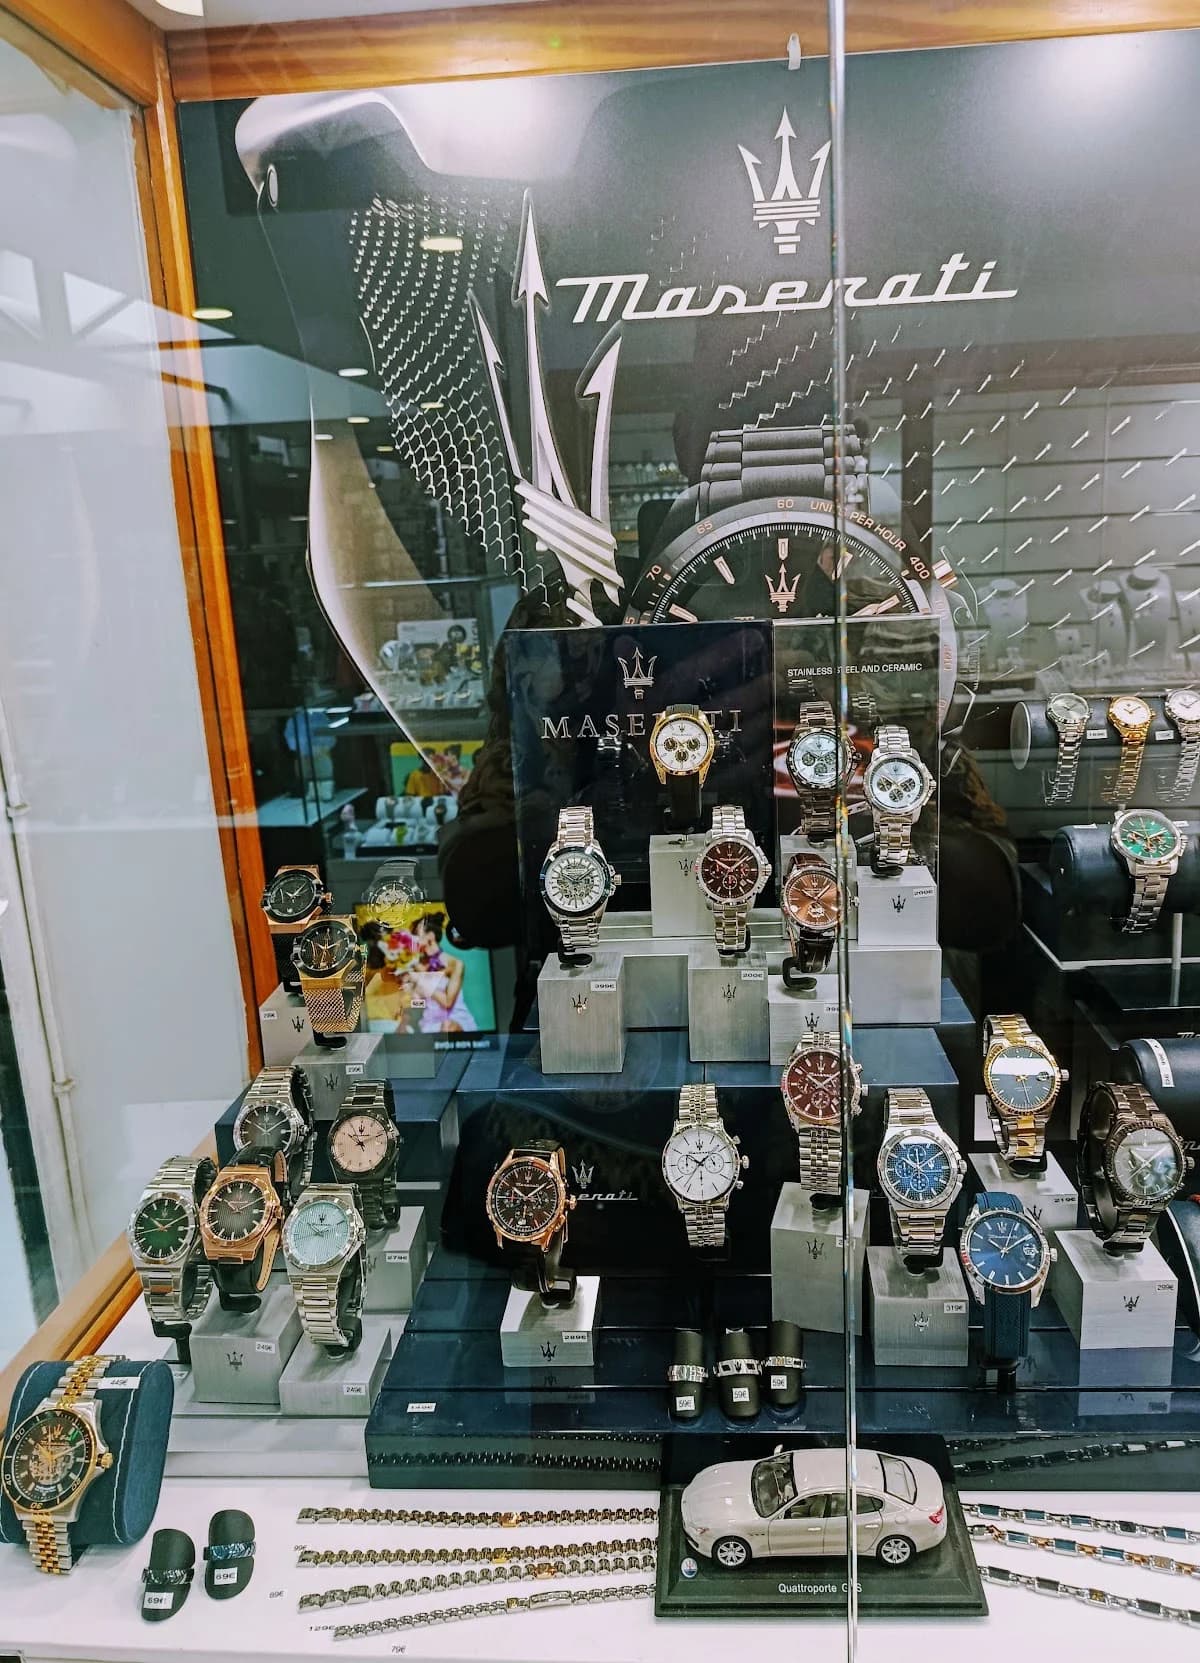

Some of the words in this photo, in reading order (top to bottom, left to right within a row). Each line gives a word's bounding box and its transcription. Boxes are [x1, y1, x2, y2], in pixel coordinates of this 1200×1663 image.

[556, 252, 1018, 323] Maserati
[777, 499, 794, 509] 60
[696, 520, 713, 534] 65
[850, 511, 873, 529] PER
[874, 524, 907, 552] HOUR
[909, 556, 931, 580] 400
[646, 565, 662, 581] 70
[787, 666, 833, 677] STAINLESS
[861, 664, 881, 674] AND
[881, 662, 923, 673] CERAMIC
[541, 709, 743, 739] MASETI
[778, 1583, 838, 1595] Quattroporte
[841, 1583, 863, 1593] GS
